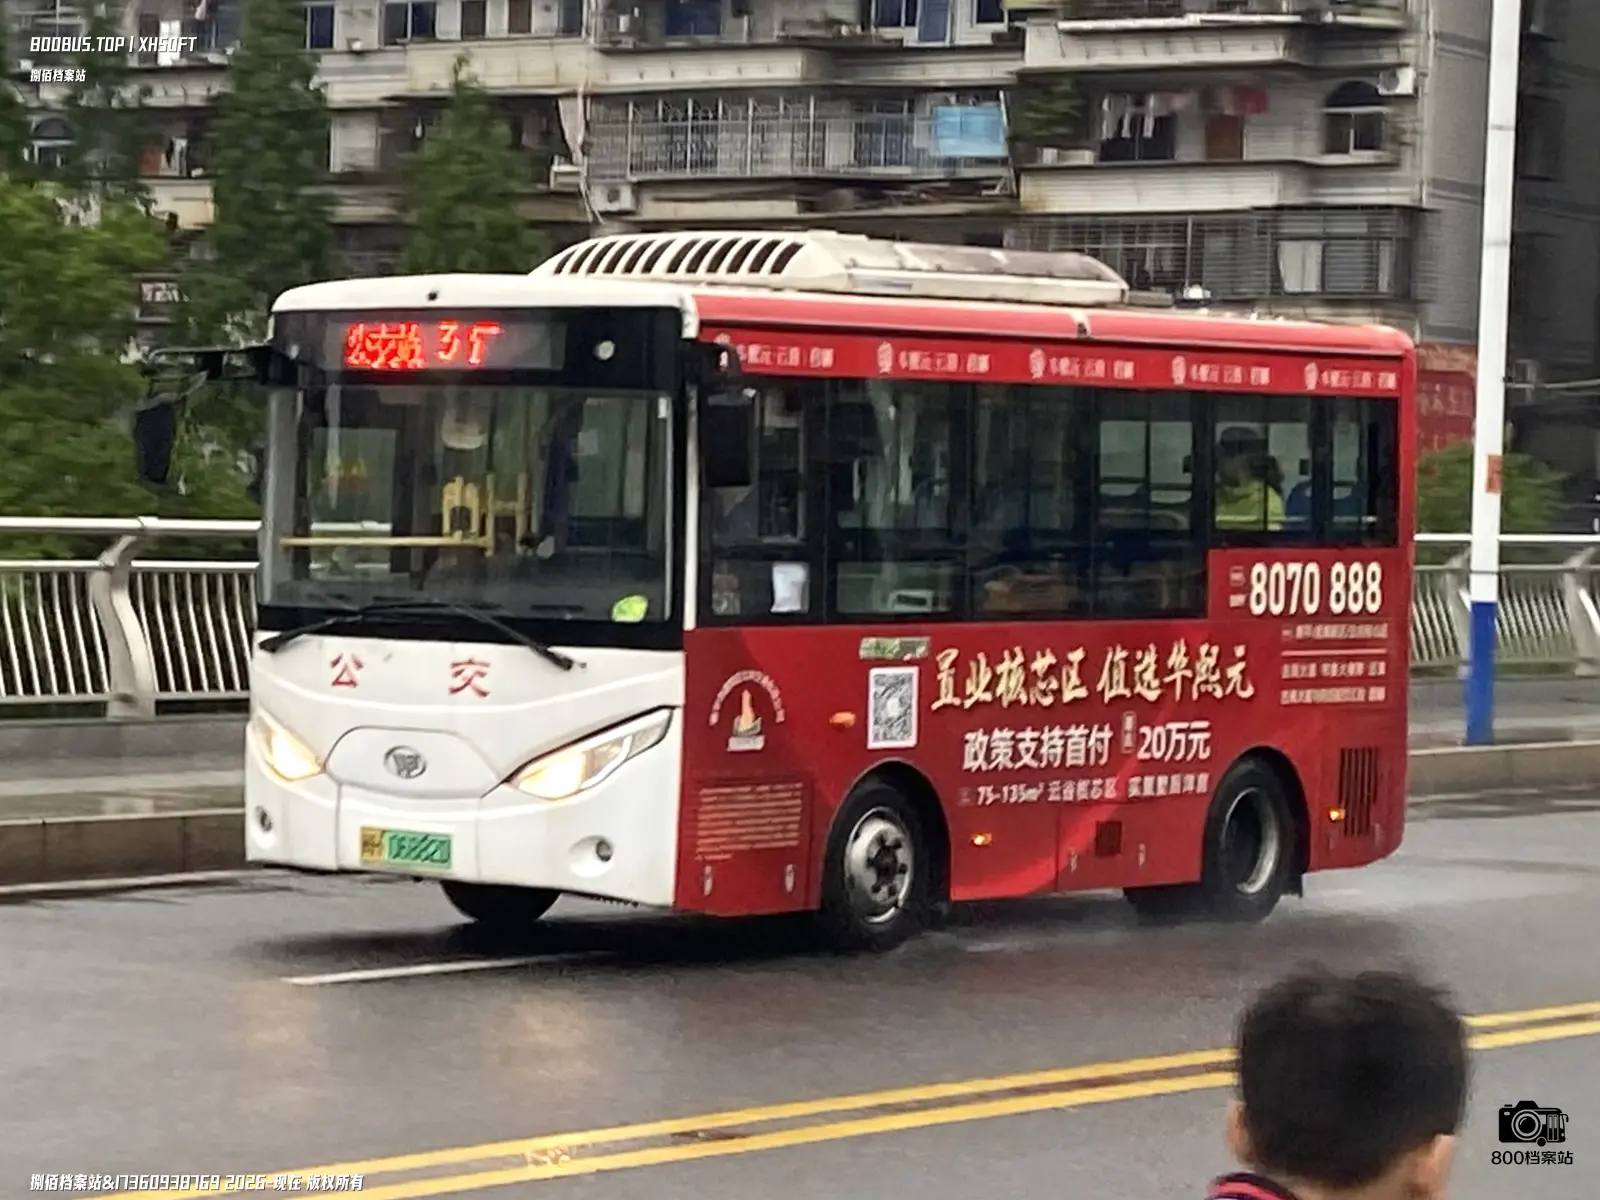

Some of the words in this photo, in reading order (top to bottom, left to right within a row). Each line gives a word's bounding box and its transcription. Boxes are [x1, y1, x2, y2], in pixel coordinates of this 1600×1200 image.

[1250, 561, 1321, 616] 8070
[1328, 561, 1382, 615] 888
[930, 645, 1089, 712] 置业核芯区
[961, 723, 1114, 773] 政策支持首付
[1136, 719, 1212, 764] 20万元
